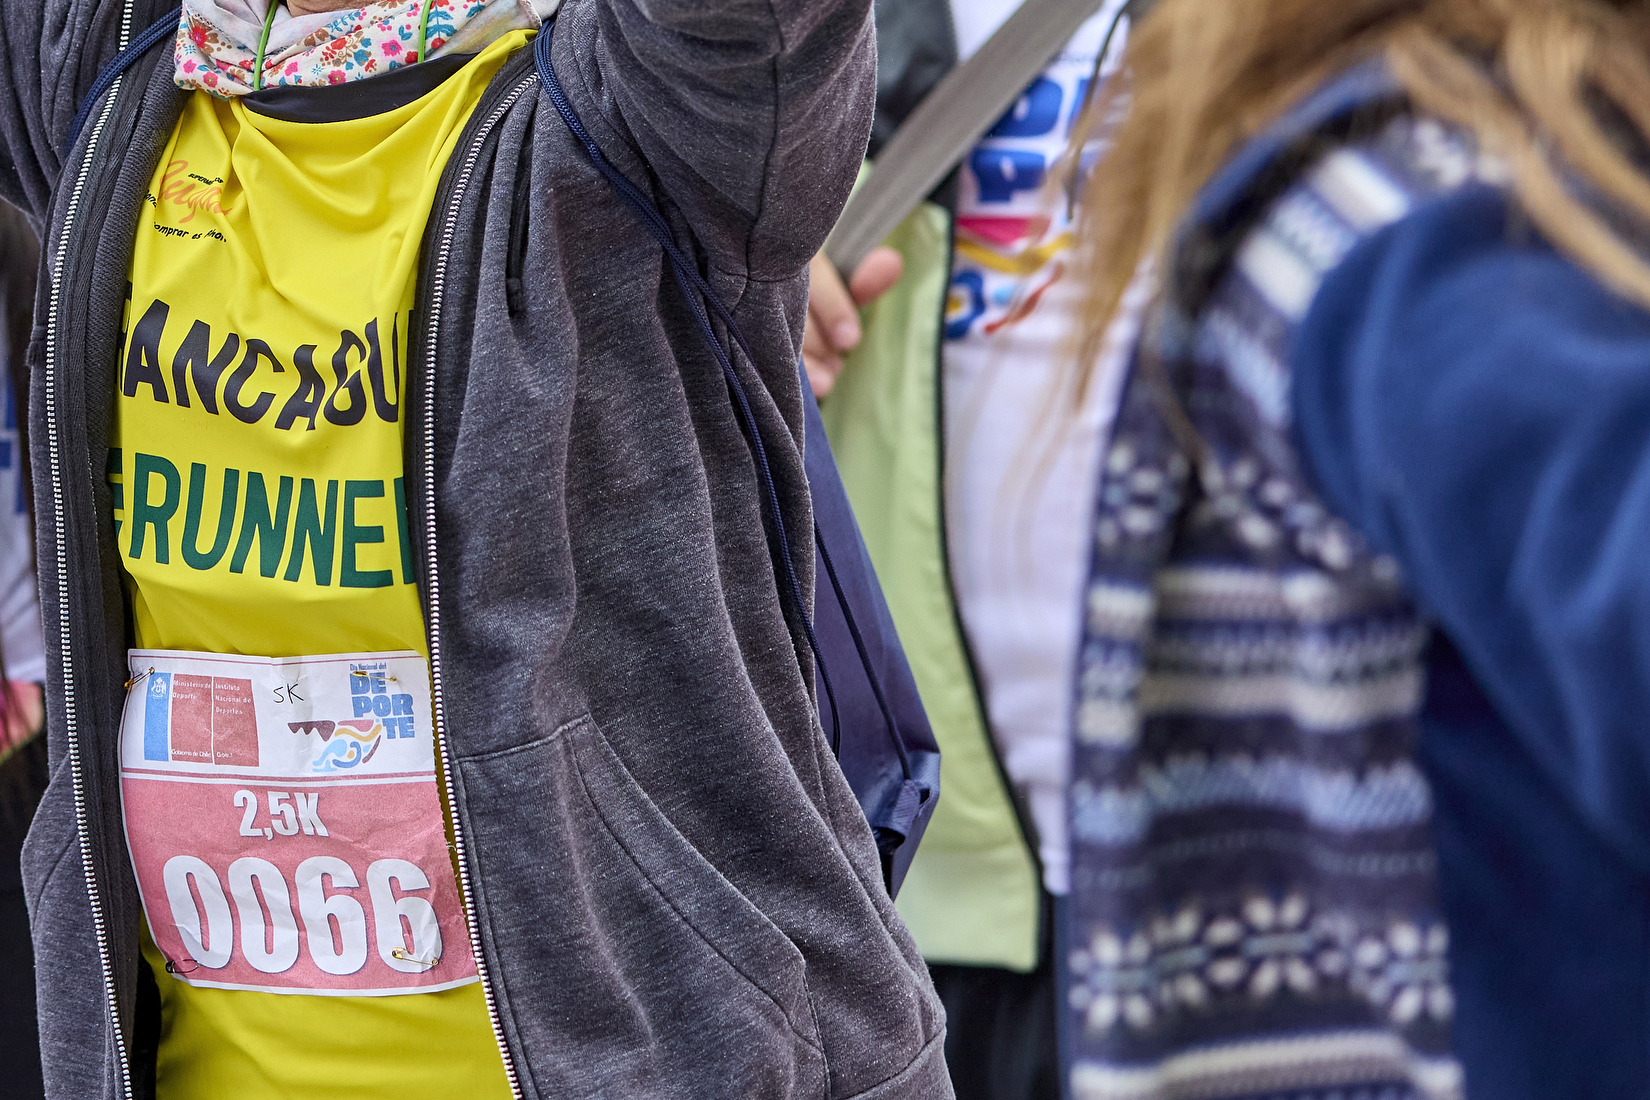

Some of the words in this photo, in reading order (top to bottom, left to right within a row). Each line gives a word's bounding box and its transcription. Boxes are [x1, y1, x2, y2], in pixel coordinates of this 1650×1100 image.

[153, 222, 189, 237] omprar
[116, 280, 414, 432] ANCAGU
[349, 671, 387, 695] DE
[172, 692, 197, 700] Deporte
[215, 695, 241, 703] Nacional
[351, 693, 414, 718] POR
[382, 716, 415, 739] TE
[233, 789, 330, 841] 2,5K
[162, 854, 444, 976] 0066
